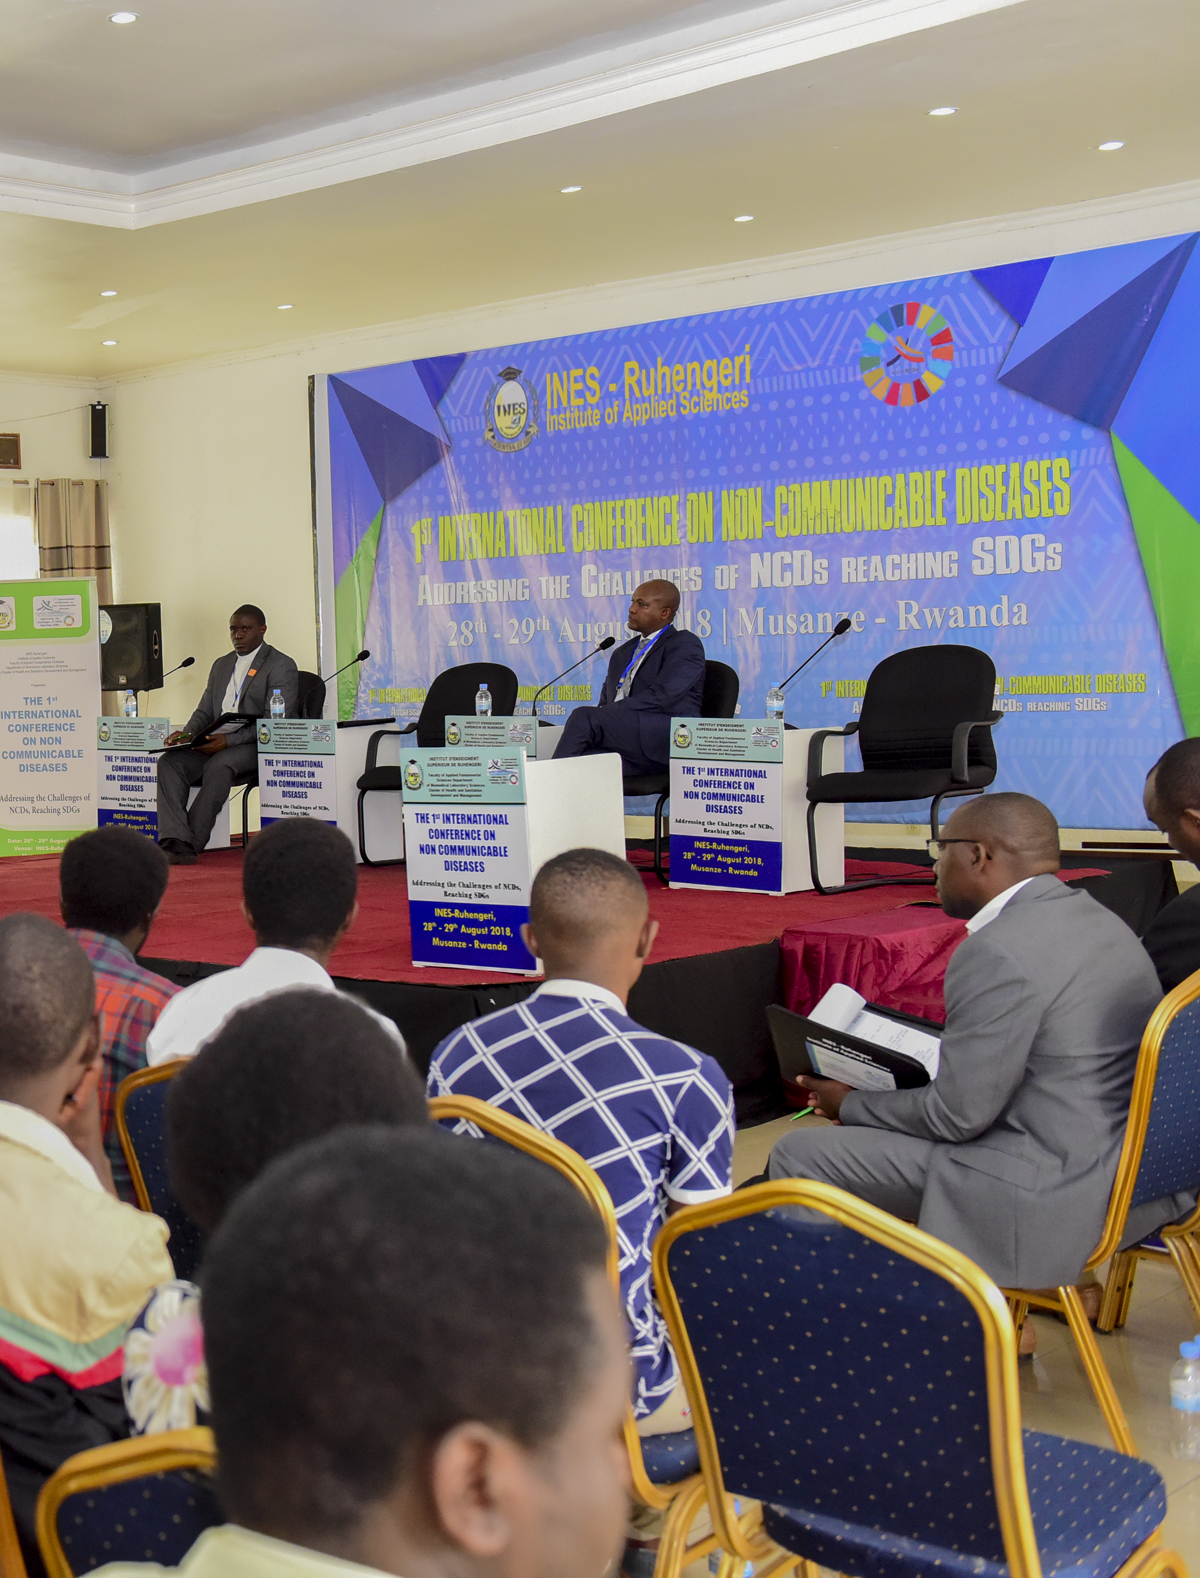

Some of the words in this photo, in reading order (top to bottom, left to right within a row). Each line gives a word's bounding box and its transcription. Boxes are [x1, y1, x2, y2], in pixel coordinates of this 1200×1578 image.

[546, 366, 600, 409] INES
[609, 382, 617, 392] -
[624, 344, 750, 399] Ruhengeri
[497, 402, 526, 417] INES
[546, 407, 601, 431] Institute
[605, 404, 619, 425] of
[623, 395, 676, 426] Applied
[680, 390, 749, 412] Sciences
[438, 504, 566, 563] INTERNATIONAL
[571, 494, 680, 553] CONFERENCE
[686, 491, 713, 544] ON
[721, 469, 947, 542] NON-COMMUNICABLE
[955, 457, 1071, 525] DISEASES
[446, 616, 488, 647] 28th
[508, 615, 550, 645] 29th
[558, 616, 640, 650] Augus
[896, 594, 1029, 631] Rwanda
[1095, 673, 1146, 694] DISEASES
[557, 684, 592, 702] DISEASES
[23, 696, 43, 706] THE
[46, 696, 58, 705] 1st
[0, 709, 82, 720] INTERNATIONAL
[8, 722, 76, 733] CONFERENCE
[22, 737, 37, 746] ON
[40, 736, 62, 745] NON
[1, 749, 84, 759] COMMUNICABLE
[19, 763, 68, 773] DISEASES
[112, 765, 142, 773] CONFERENCE
[282, 760, 324, 768] INTERNATIONAL
[117, 775, 158, 783] COMMUNICABLE
[273, 769, 306, 778] CONFERENCE
[682, 766, 697, 775] THE
[707, 767, 767, 779] INTERNATIONAL
[266, 779, 277, 787] NON
[279, 780, 323, 789] COMMUNICABLE
[693, 778, 742, 790] CONFERENCE
[743, 780, 755, 791] ON
[0, 794, 35, 804] Addressing
[36, 794, 46, 802] the
[47, 794, 83, 803] Challenges
[84, 793, 91, 801] of
[282, 790, 308, 799] DISEASES
[683, 790, 699, 800] NON
[701, 791, 765, 804] COMMUNICABLE
[9, 806, 30, 815] NCDs,
[31, 806, 61, 816] Reaching
[62, 806, 80, 814] SDGs
[705, 803, 743, 815] DISEASES
[415, 813, 430, 824] THE
[442, 813, 509, 825] INTERNATIONAL
[674, 818, 705, 827] Addressing
[717, 820, 749, 829] Challenges
[757, 823, 774, 831] NCDs,
[428, 828, 482, 841] CONFERENCE
[483, 830, 496, 841] ON
[703, 827, 730, 836] Reaching
[731, 828, 746, 836] SDGs
[419, 843, 436, 855] NON
[438, 844, 509, 858] COMMUNICABLE
[694, 841, 750, 853] INES-Ruhengeri,
[683, 851, 696, 860] 28th
[702, 854, 715, 862] 29th
[717, 855, 742, 865] August
[743, 856, 764, 866] 2018,
[444, 860, 485, 873] DISEASES
[690, 863, 722, 873] Musanze
[728, 867, 758, 877] Rwanda
[411, 879, 445, 889] Addressing
[446, 880, 457, 889] the
[458, 881, 493, 891] Challenges
[503, 883, 521, 892] NCDs,
[443, 890, 473, 900] Reaching
[473, 891, 490, 899] SDGs
[434, 907, 497, 922] INES-Ruhengeri,
[423, 921, 437, 931] 28th
[444, 923, 458, 933] 29th
[460, 924, 488, 936] August
[490, 926, 514, 938] 2018,
[432, 937, 467, 948] Musanze
[474, 940, 508, 951] Rwanda
